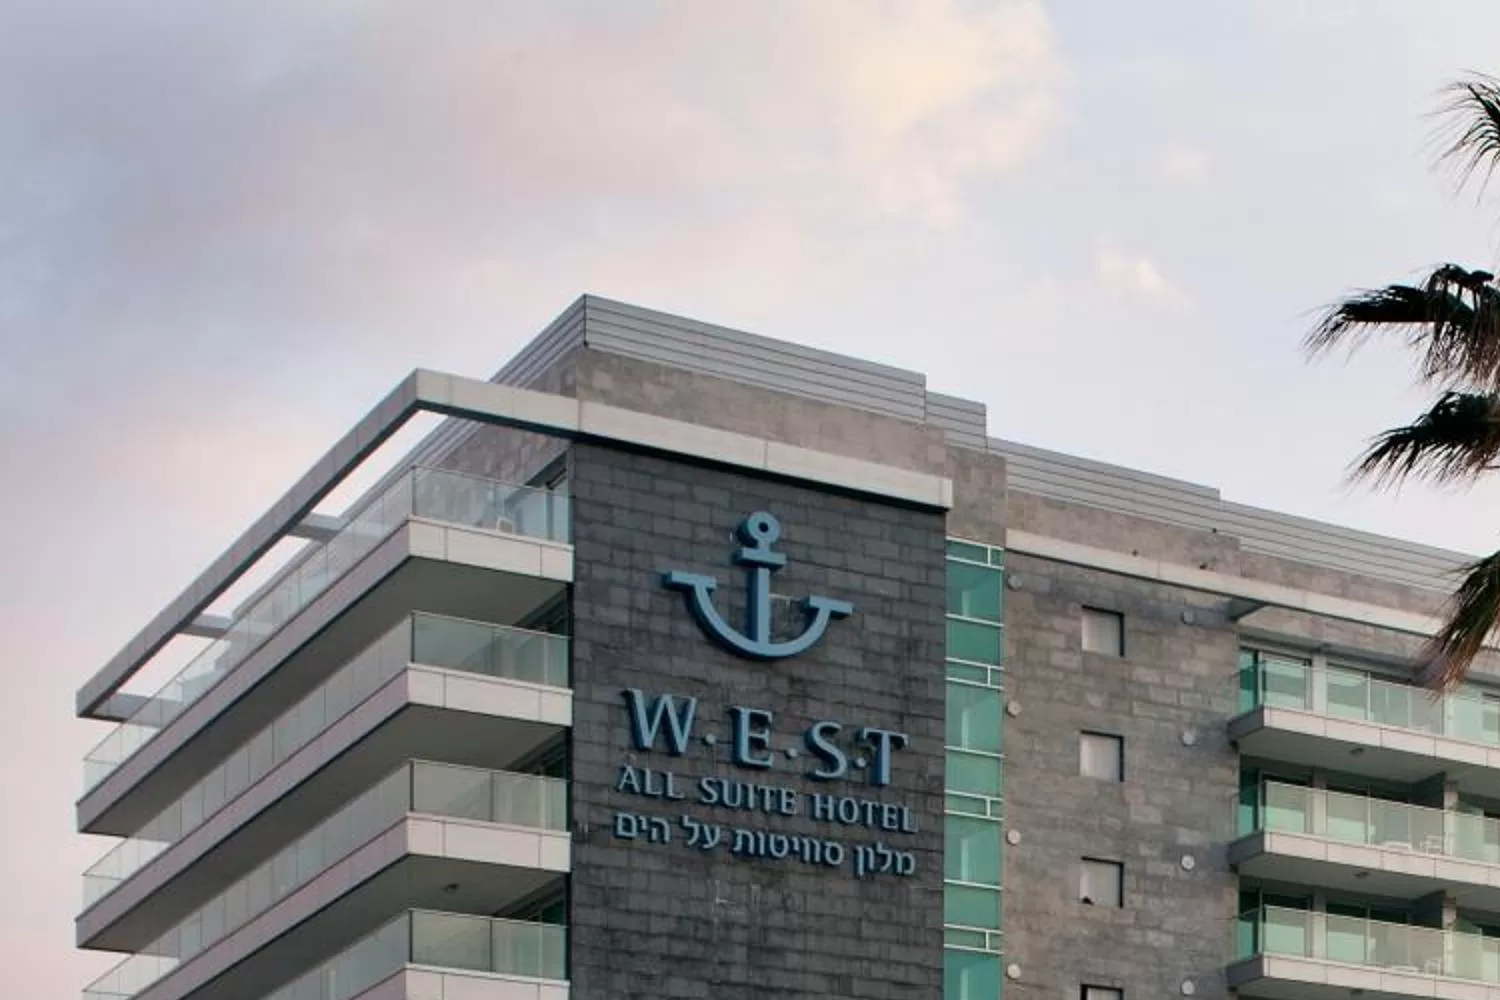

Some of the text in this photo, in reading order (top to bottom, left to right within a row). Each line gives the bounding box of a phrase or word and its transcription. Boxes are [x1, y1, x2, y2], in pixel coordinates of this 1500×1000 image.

[616, 761, 919, 834] ALL SUITE HOTEL
[613, 811, 917, 877] מלון סוויטות על הים
